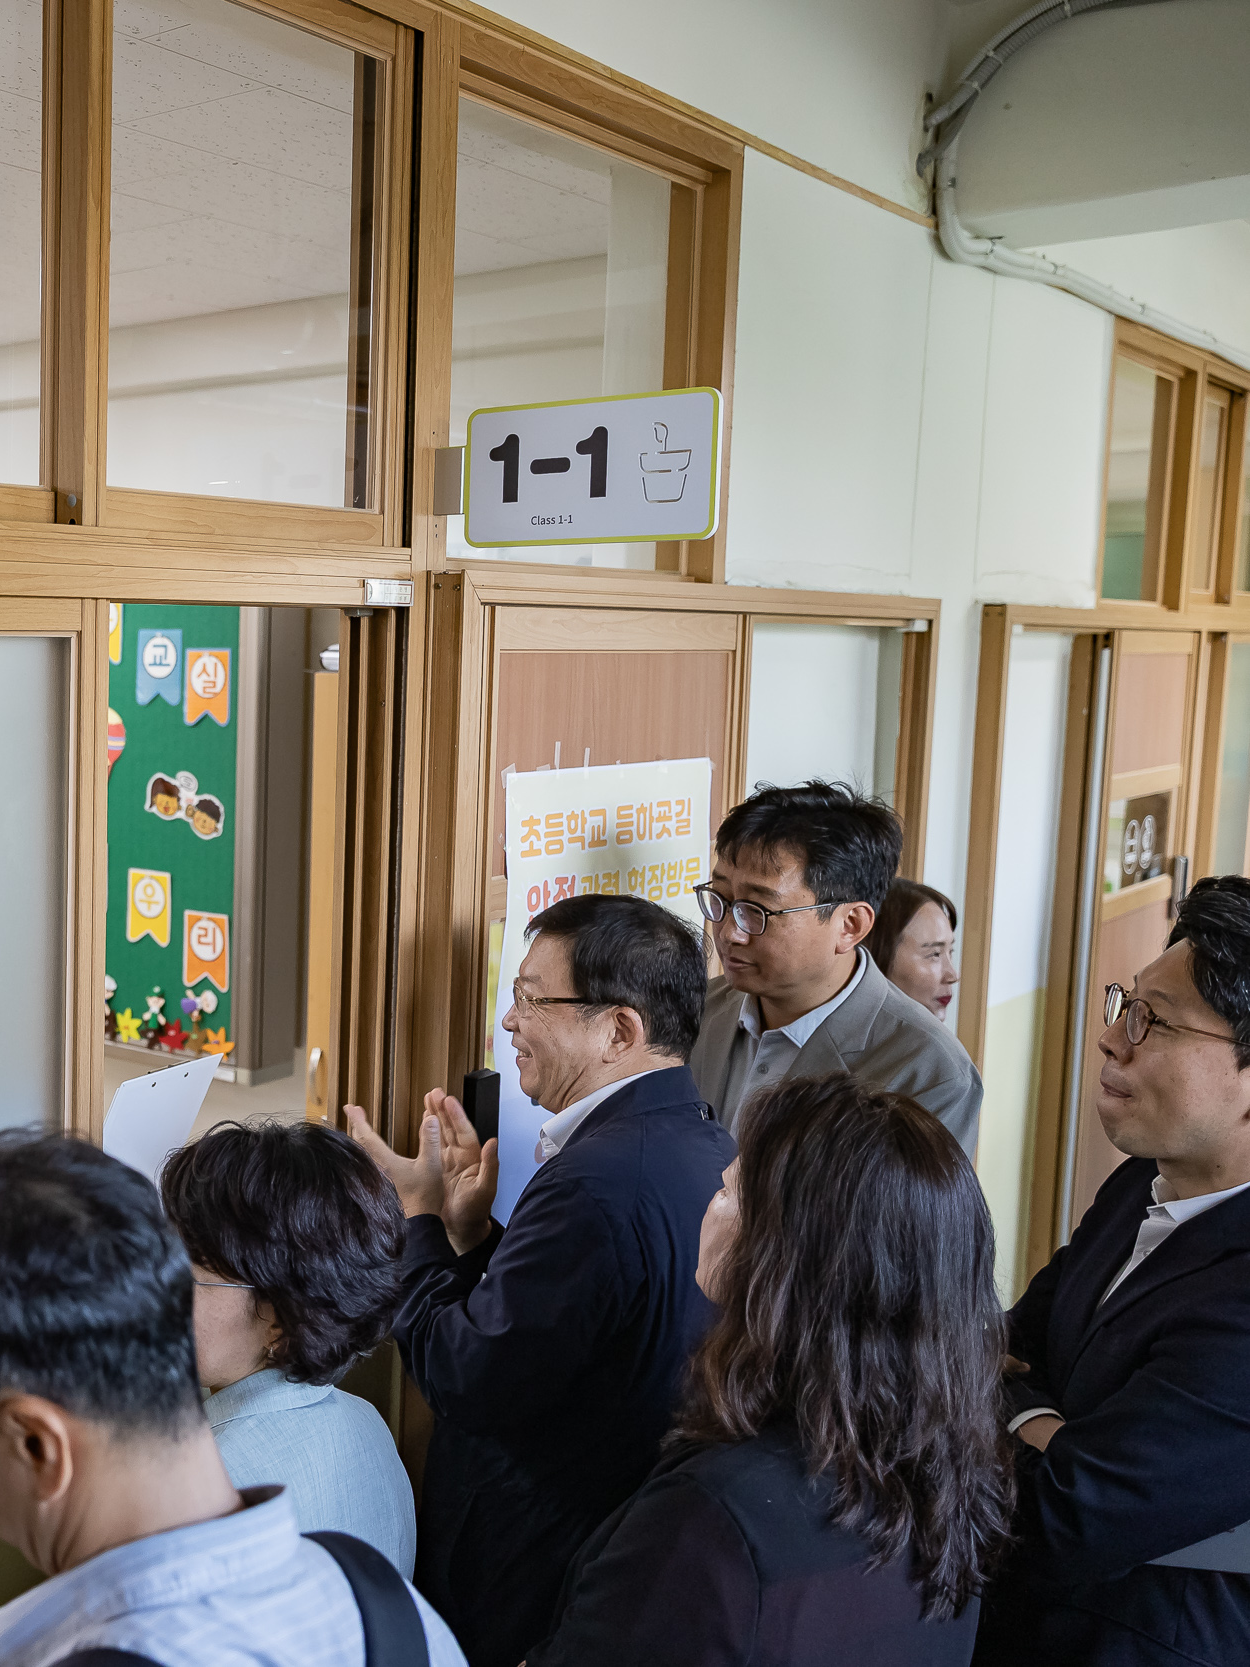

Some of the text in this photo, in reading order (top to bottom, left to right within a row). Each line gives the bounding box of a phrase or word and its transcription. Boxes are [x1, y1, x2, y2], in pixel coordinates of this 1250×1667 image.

[489, 426, 609, 504] 1-1
[530, 514, 574, 526] Class 1-1
[520, 797, 692, 859] 초등학교 등하굣길
